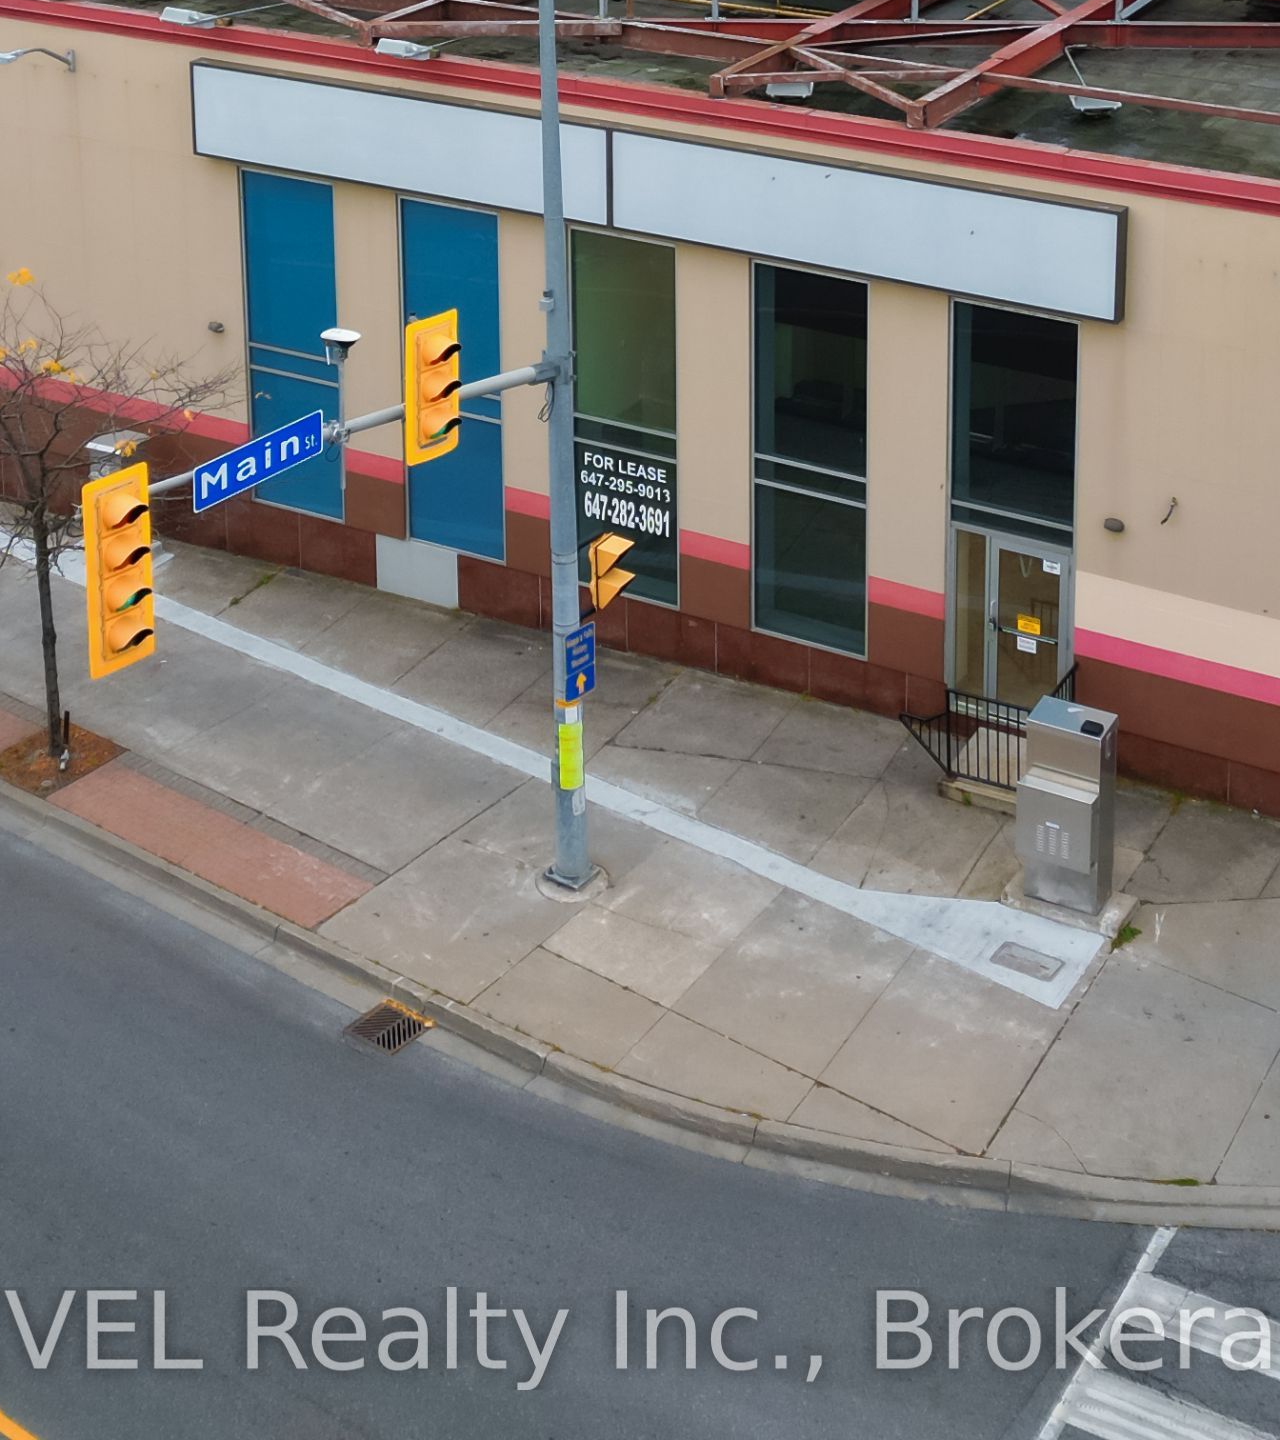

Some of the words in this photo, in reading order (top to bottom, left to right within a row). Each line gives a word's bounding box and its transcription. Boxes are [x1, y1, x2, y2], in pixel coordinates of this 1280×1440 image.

[200, 435, 300, 500] Main
[305, 433, 318, 450] St.
[580, 470, 671, 503] 647-295-9013
[584, 451, 614, 472] FOR
[618, 459, 667, 484] LEASE
[584, 490, 670, 538] 647-282-3691
